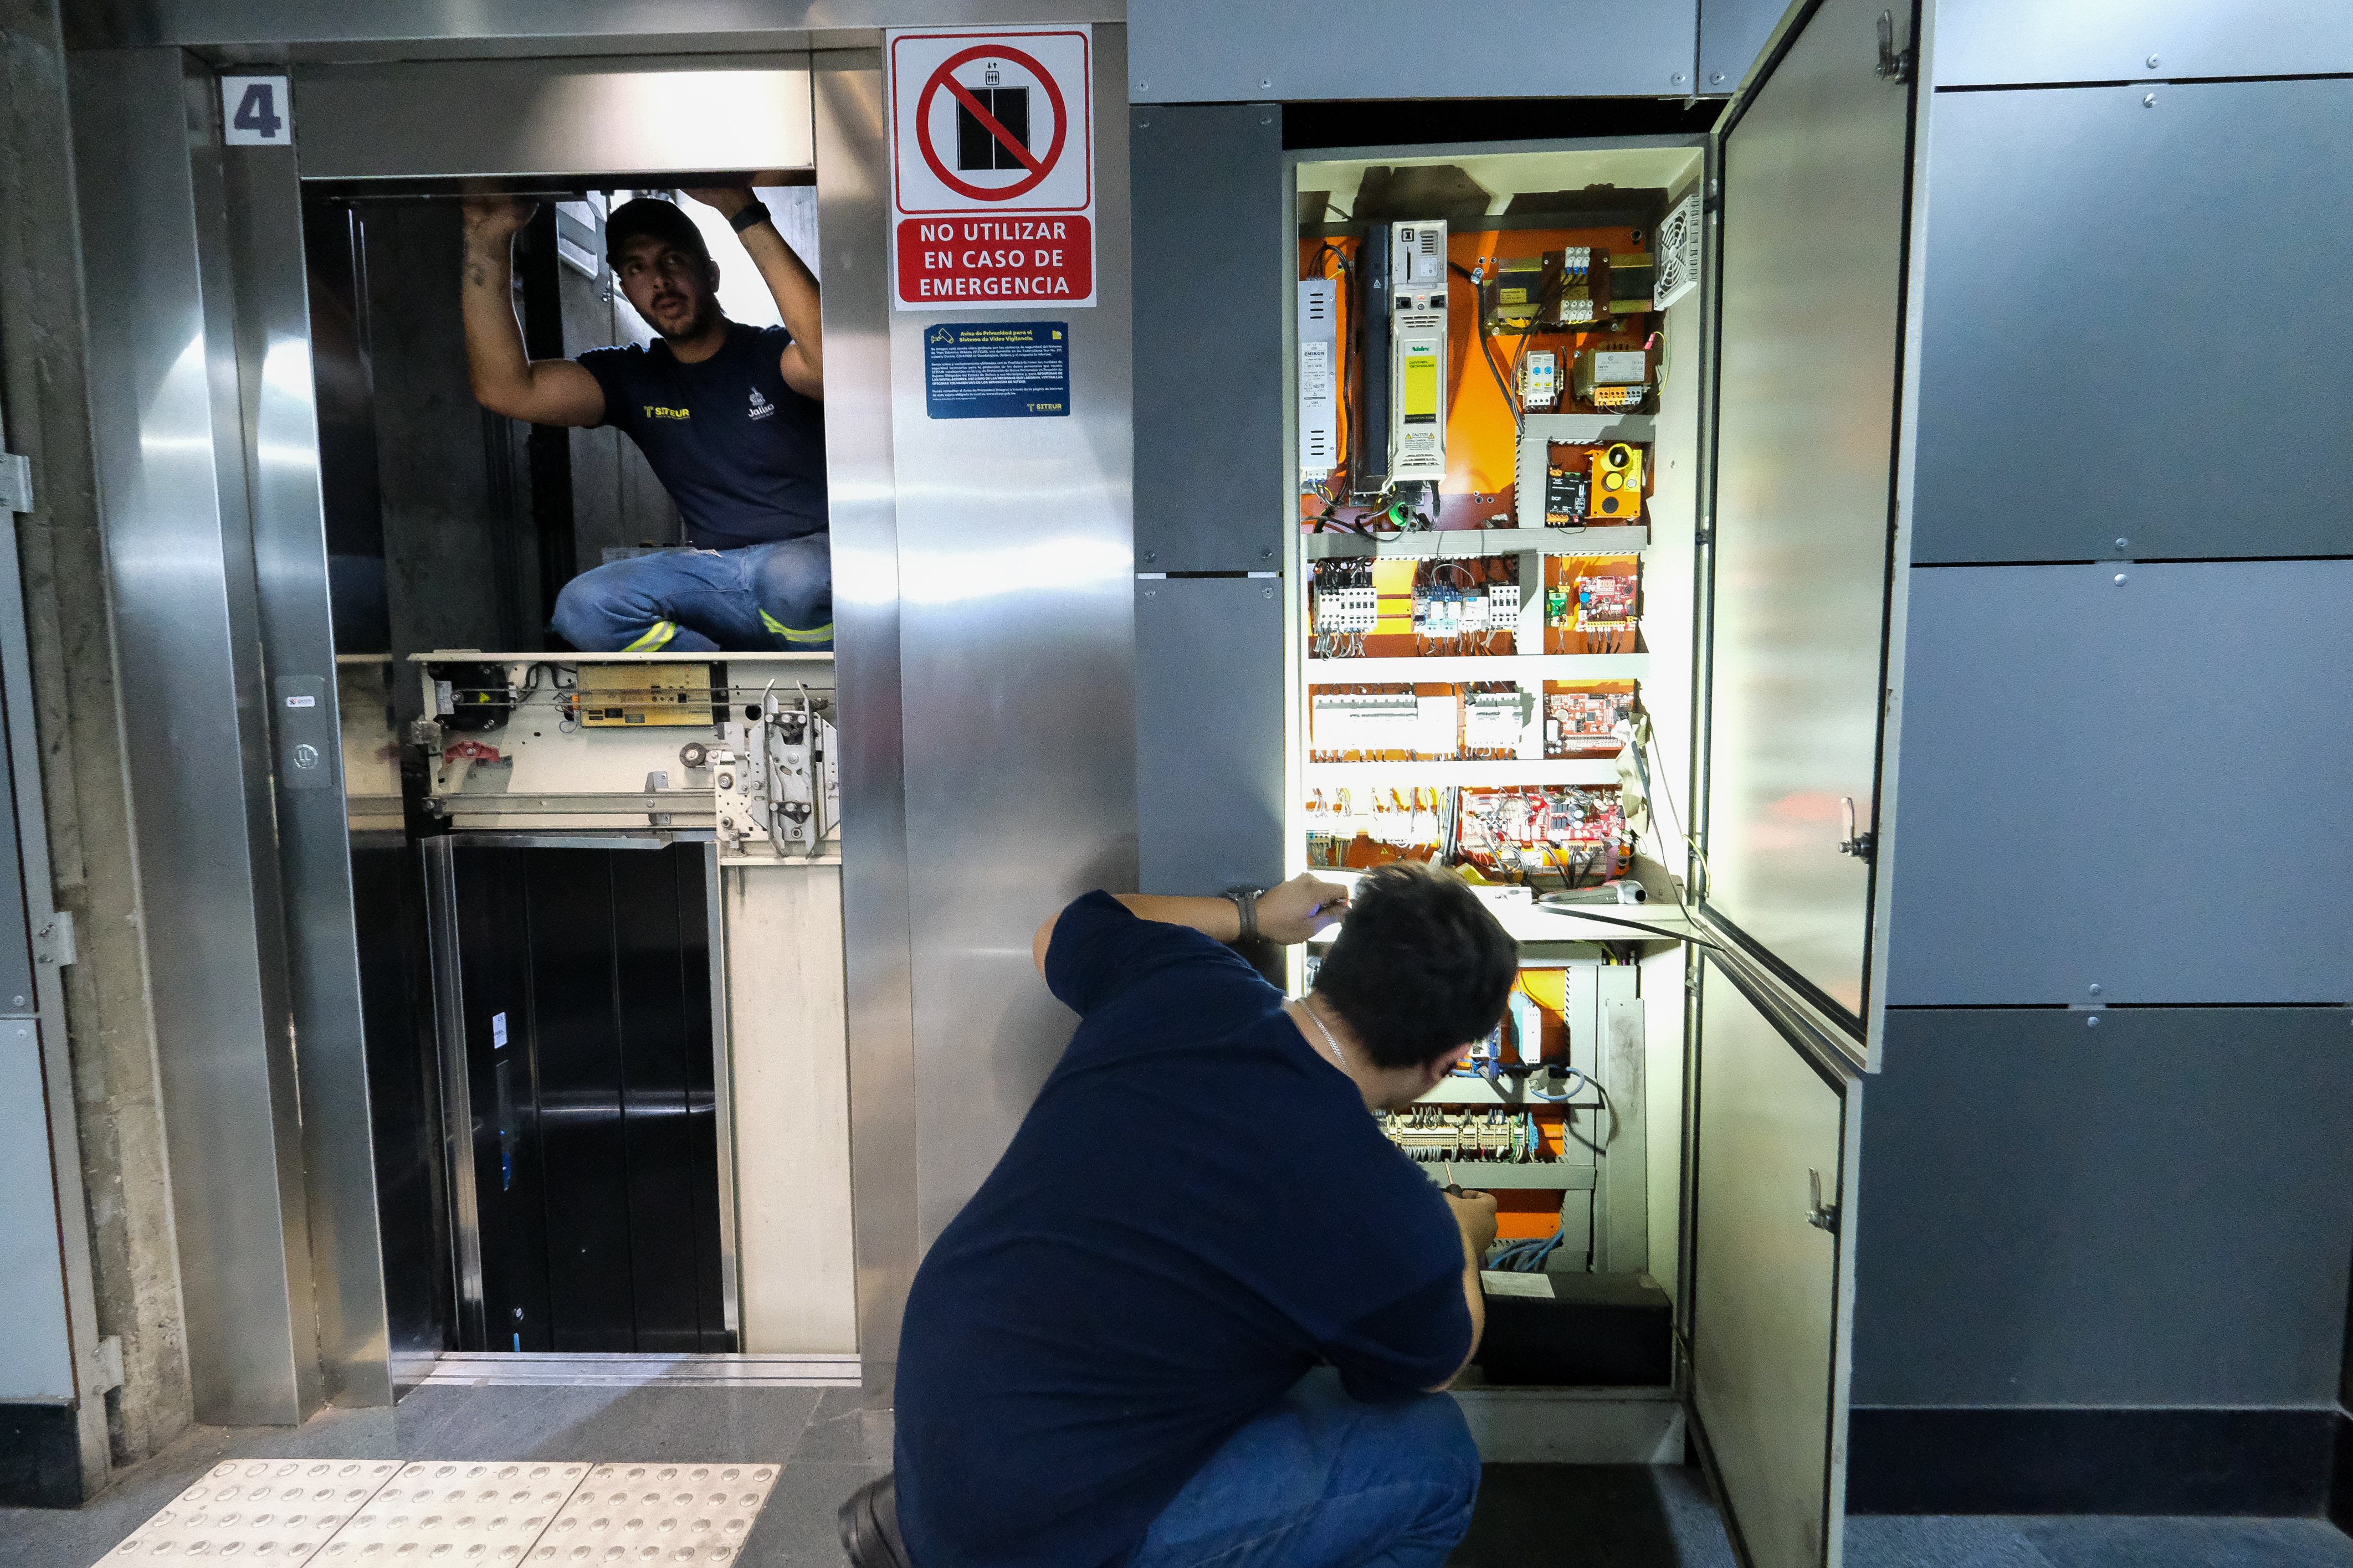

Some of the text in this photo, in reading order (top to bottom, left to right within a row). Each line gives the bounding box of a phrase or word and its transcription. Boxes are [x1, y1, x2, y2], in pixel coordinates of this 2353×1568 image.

[234, 84, 281, 138] 4
[920, 222, 1066, 241] NO UTILIZAR
[925, 250, 1063, 269] EN CASO DE
[920, 277, 1069, 296] EMERGENCIA
[655, 407, 690, 418] SITEUR
[748, 404, 775, 417] Jalio
